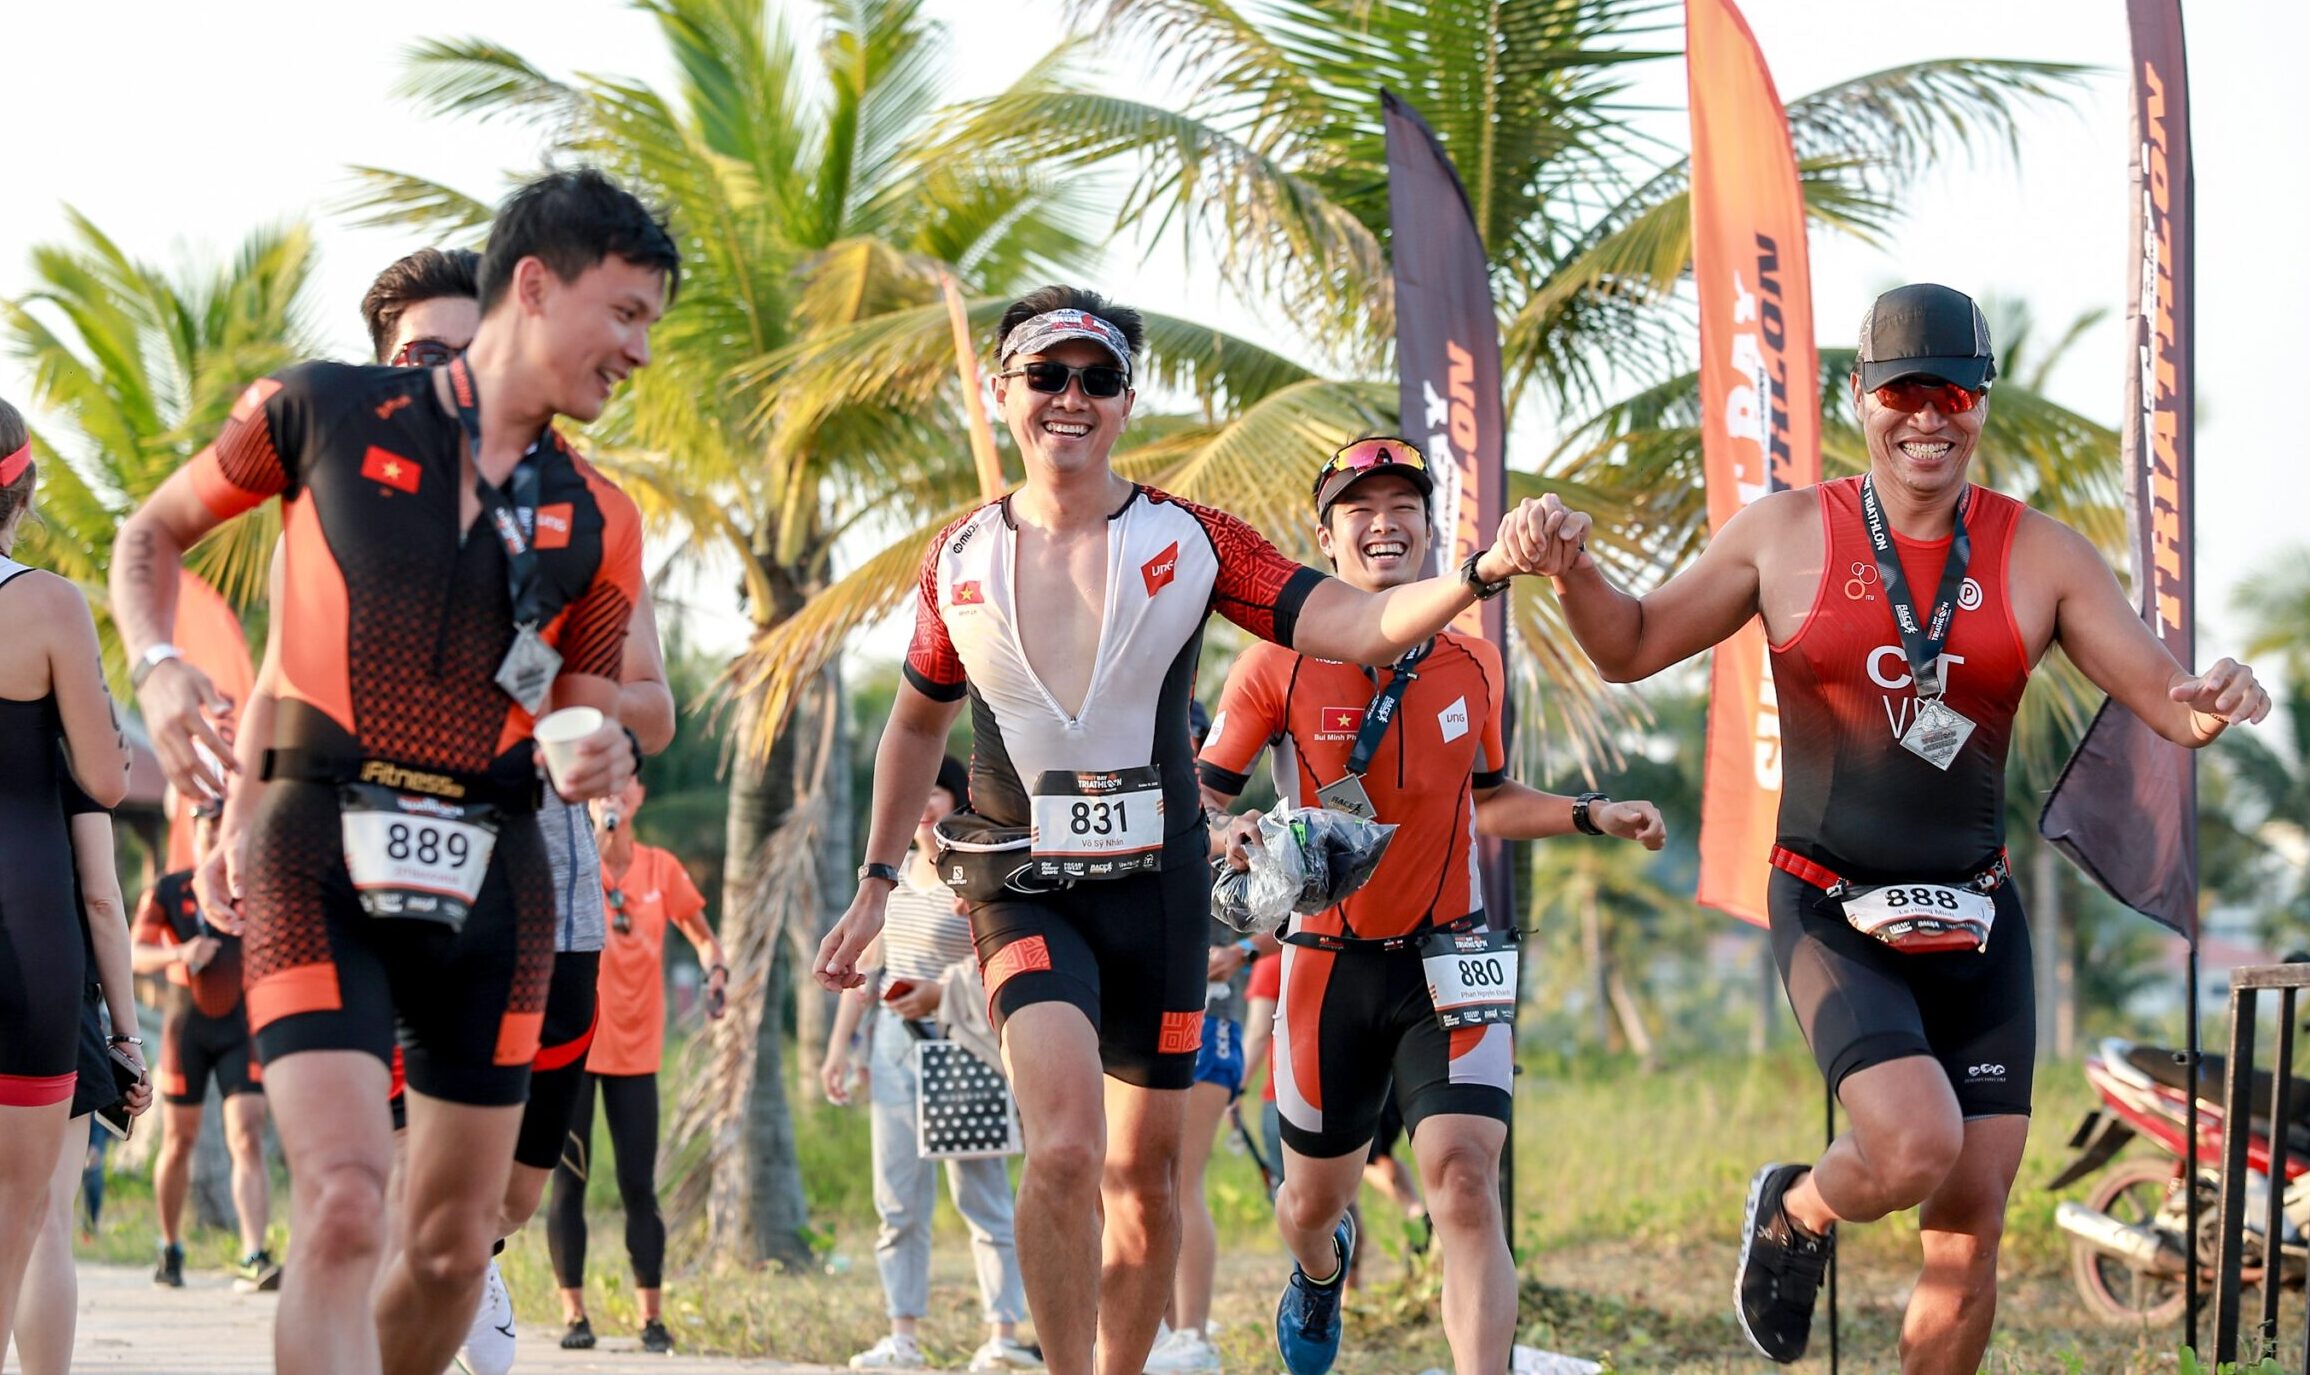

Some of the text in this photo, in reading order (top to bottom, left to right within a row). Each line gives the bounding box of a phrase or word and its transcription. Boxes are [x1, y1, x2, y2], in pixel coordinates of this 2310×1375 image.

[1755, 232, 1792, 493] THLON
[2145, 61, 2181, 631] TRIATHLON
[1864, 487, 1888, 551] TRIATHLON
[1327, 733, 1345, 741] Minh
[1078, 778, 1122, 788] TRIATHLON
[1071, 800, 1128, 835] 831
[388, 823, 469, 868] 889
[1885, 888, 1958, 910] 888
[1458, 958, 1504, 987] 880
